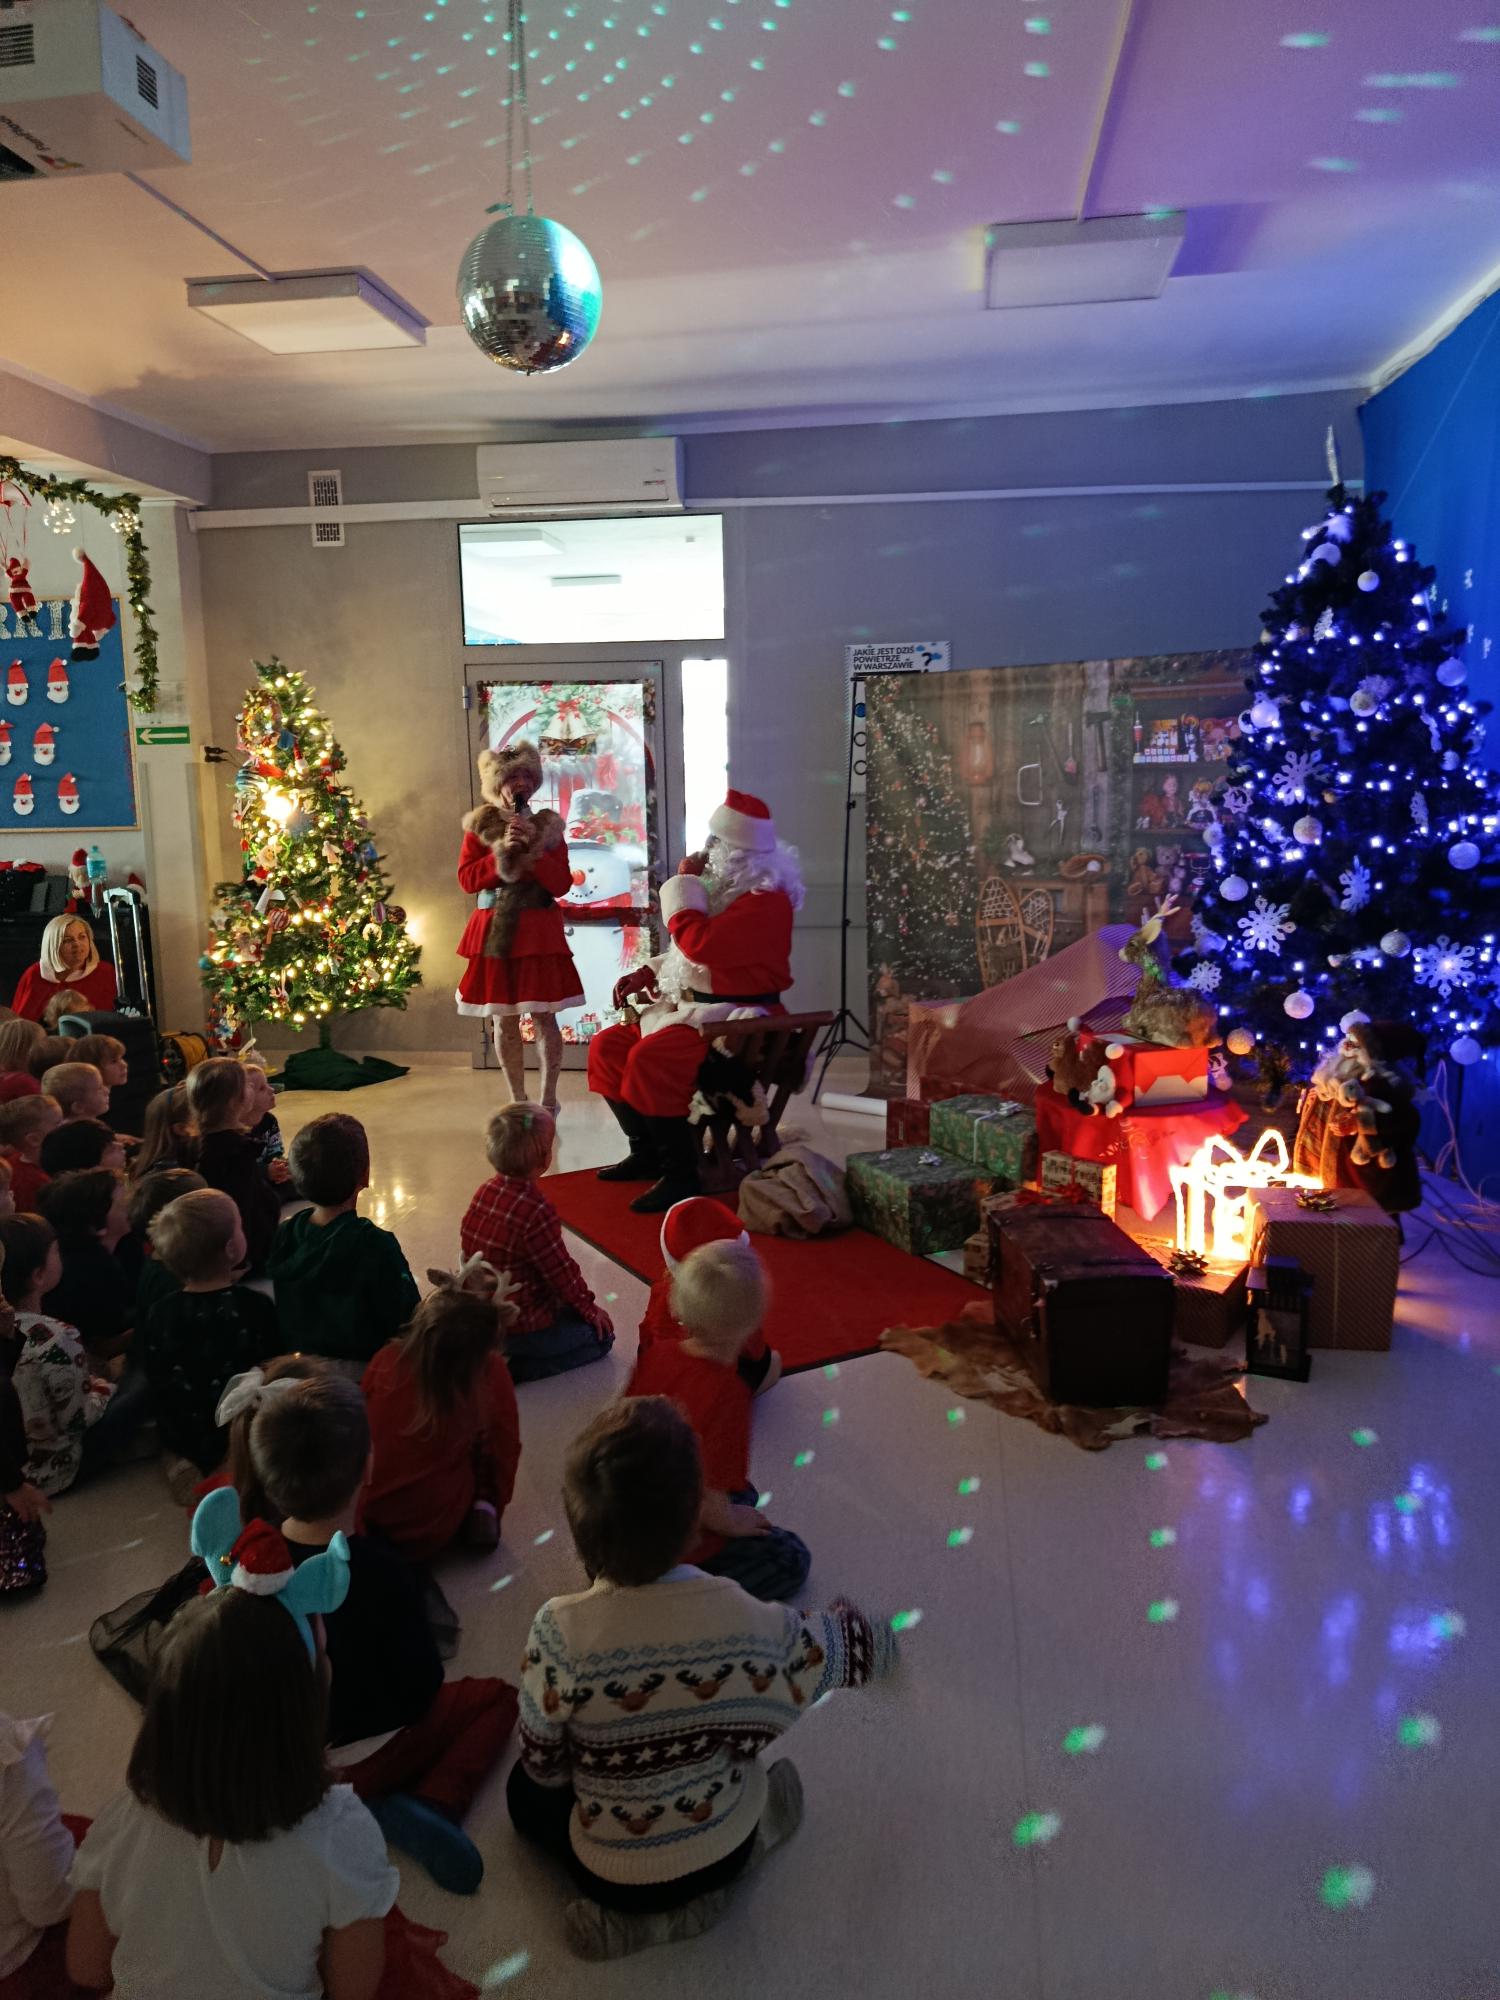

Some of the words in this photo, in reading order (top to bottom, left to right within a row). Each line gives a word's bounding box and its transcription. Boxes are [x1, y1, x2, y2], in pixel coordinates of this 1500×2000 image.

[853, 648, 875, 656] JAKIE
[877, 647, 894, 655] JEST
[896, 646, 915, 654] DZIŚ
[853, 655, 901, 663] POWIETRZE
[853, 663, 862, 671] W
[864, 661, 914, 670] WARSZAWIE
